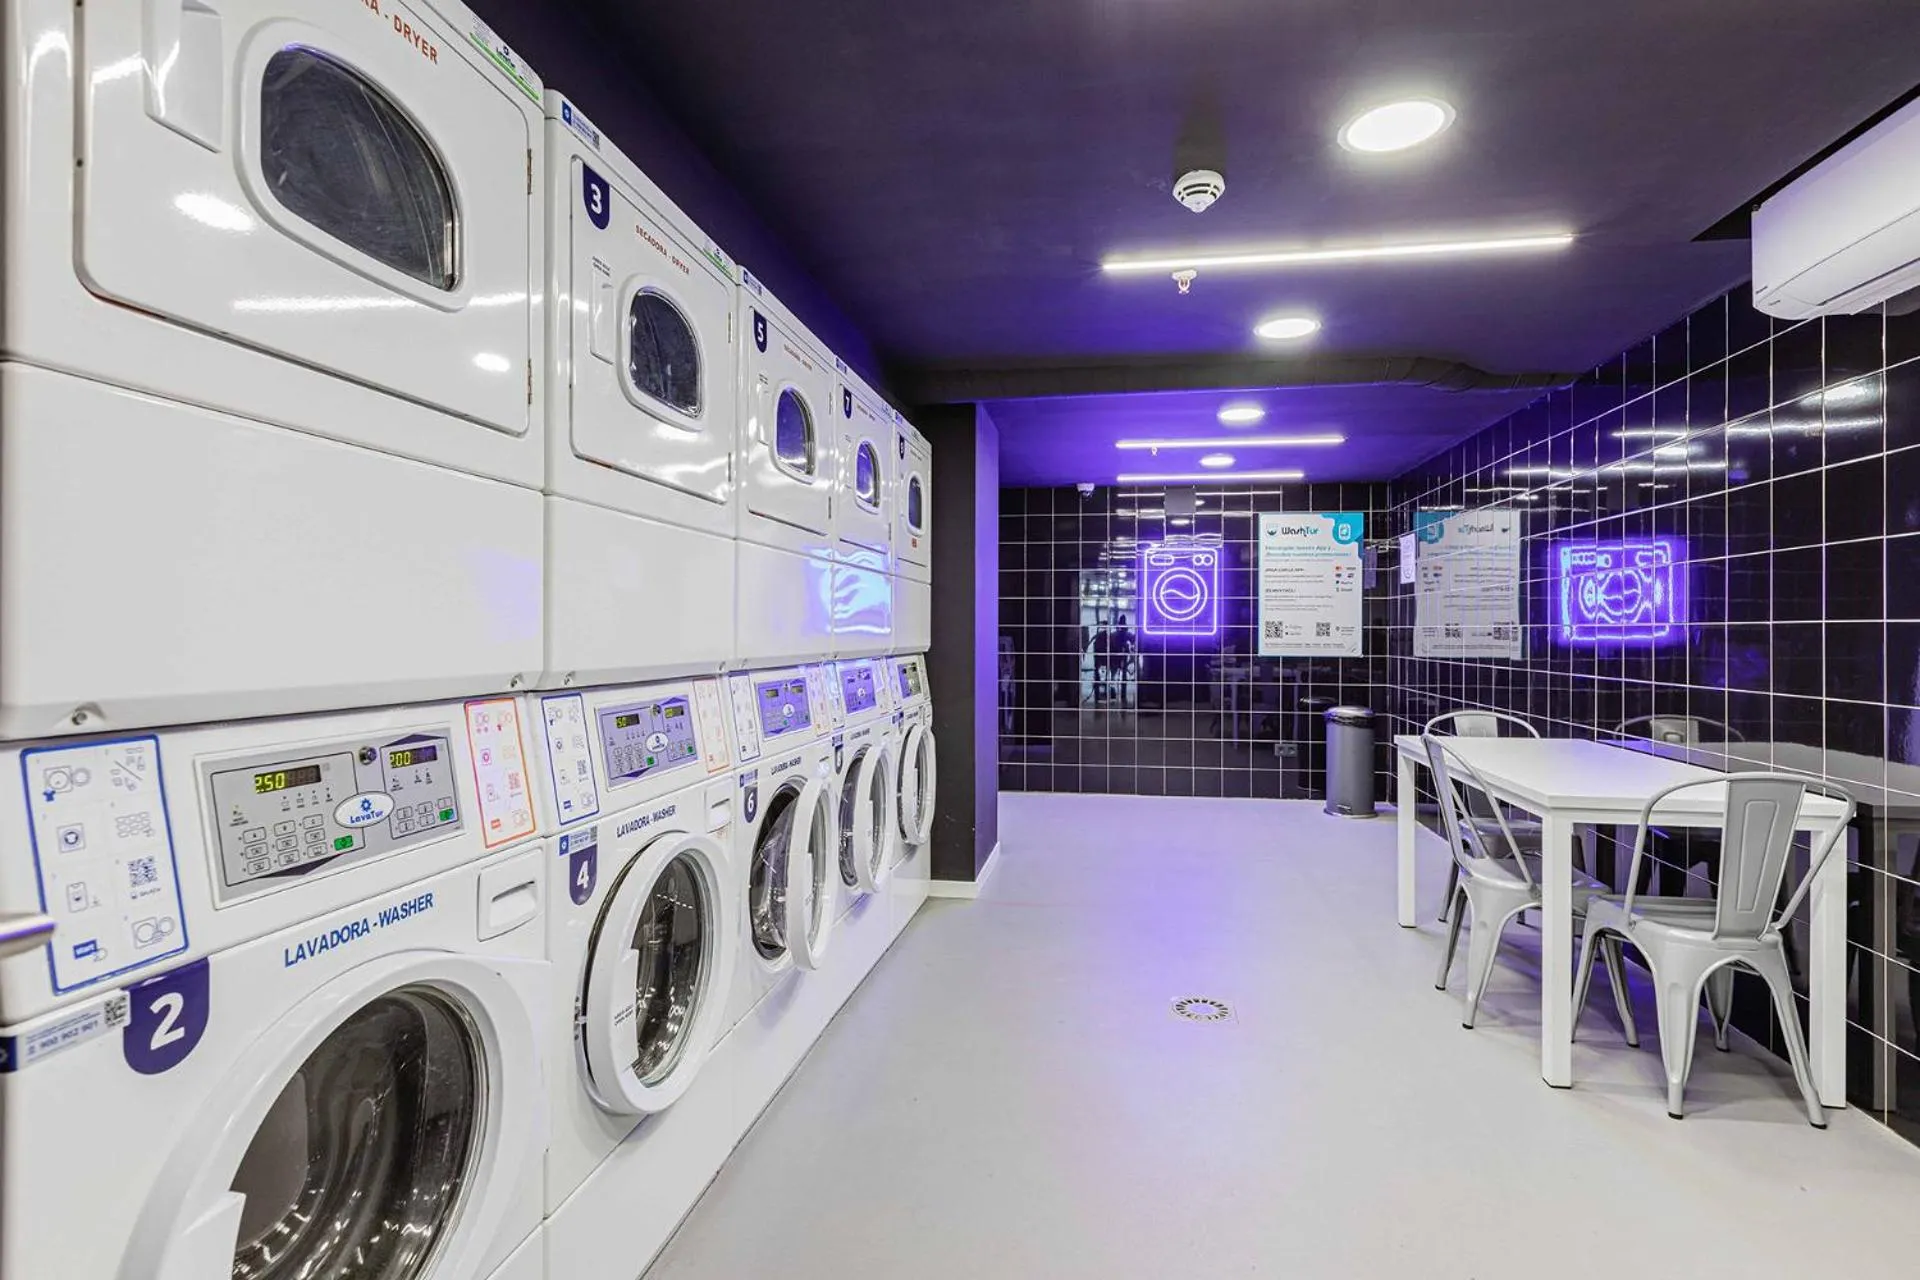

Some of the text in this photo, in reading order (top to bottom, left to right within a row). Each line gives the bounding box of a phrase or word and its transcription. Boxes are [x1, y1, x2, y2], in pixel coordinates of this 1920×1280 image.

[393, 14, 439, 65] DRYER
[590, 183, 602, 215] 3
[635, 224, 667, 257] SECADORA
[671, 255, 690, 276] DRYER
[757, 321, 764, 343] 5
[845, 394, 850, 412] 7
[1281, 526, 1320, 538] WashTur
[349, 810, 384, 824] LavaTur
[748, 792, 754, 813] 6
[616, 814, 650, 838] LAVADORA
[652, 805, 676, 822] WASHER
[576, 860, 589, 889] 4
[284, 918, 370, 967] LAVADORA
[378, 892, 434, 929] WASHER
[150, 992, 185, 1051] 2
